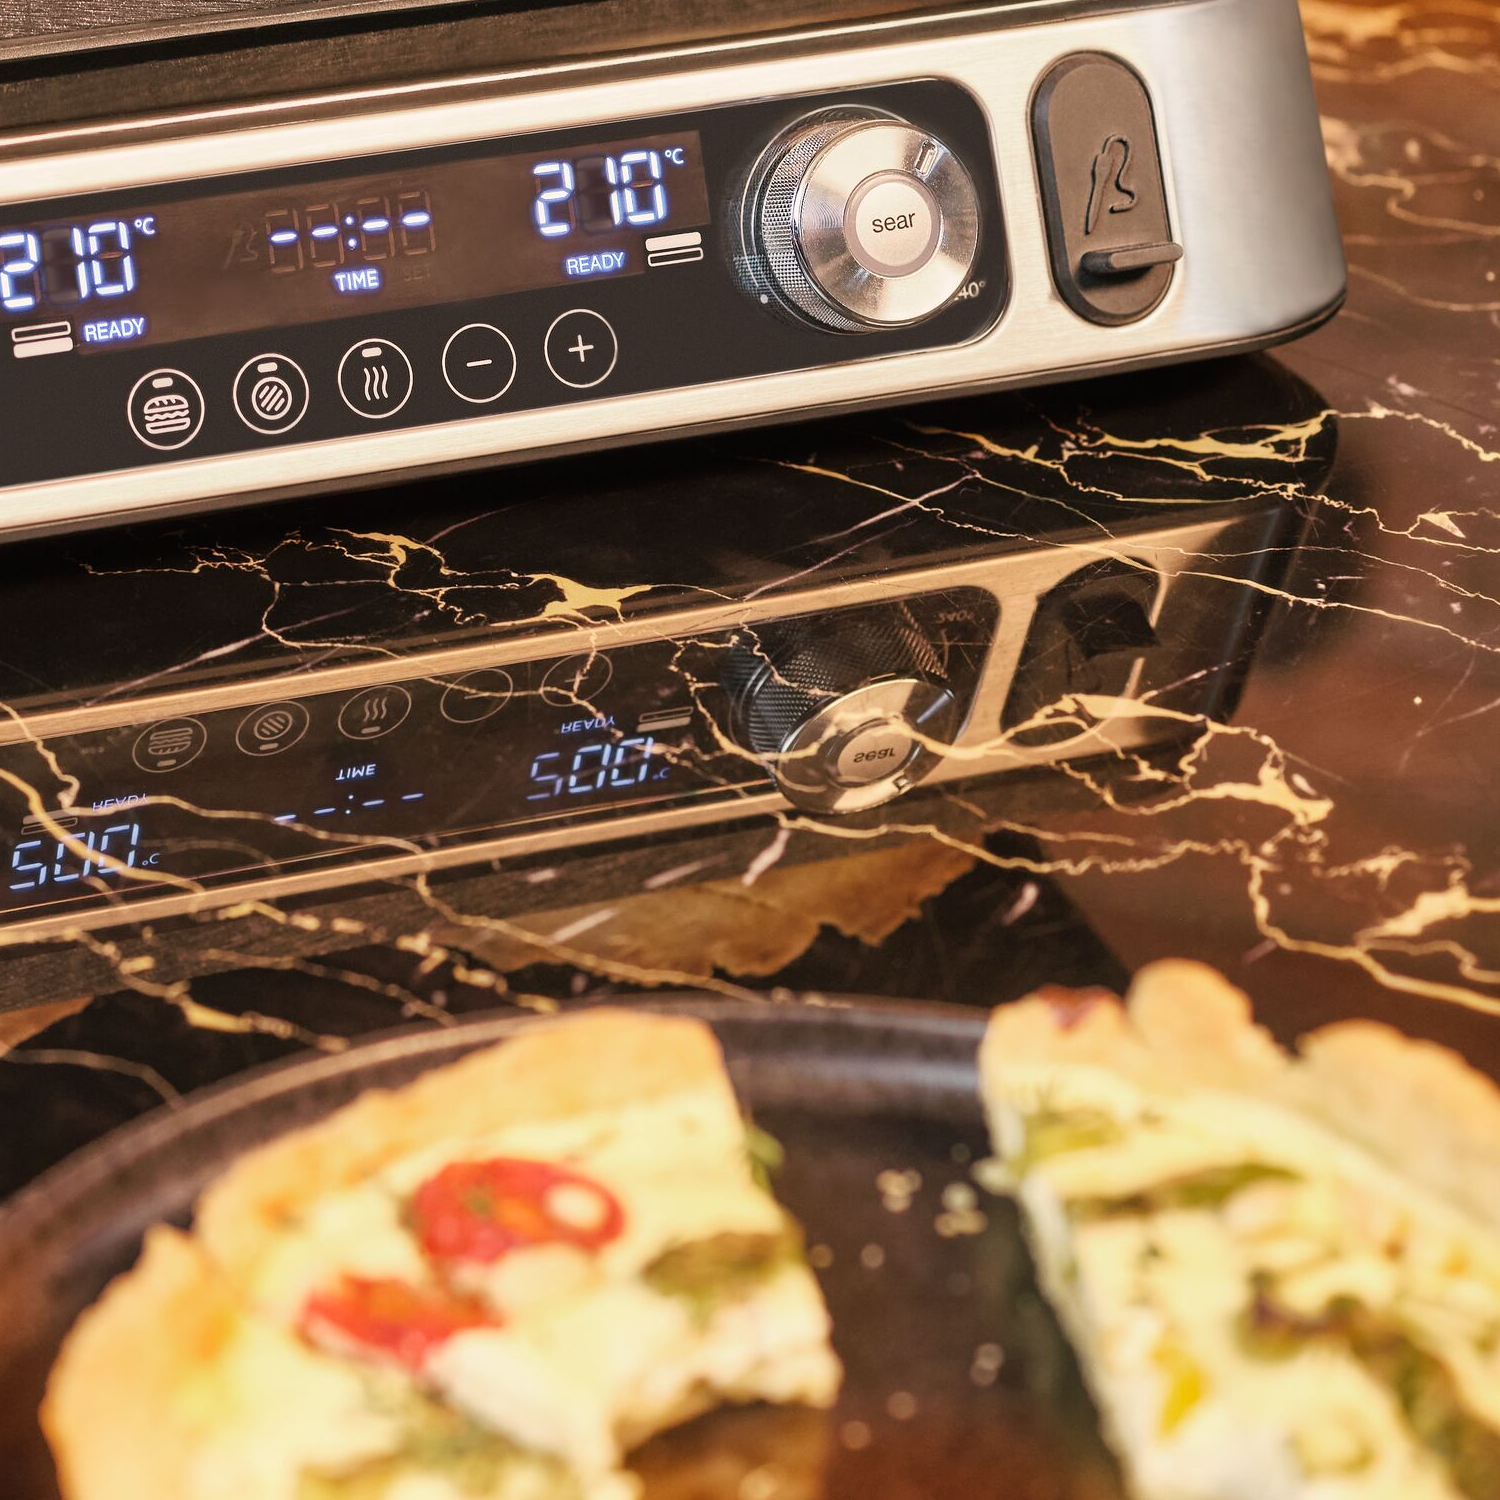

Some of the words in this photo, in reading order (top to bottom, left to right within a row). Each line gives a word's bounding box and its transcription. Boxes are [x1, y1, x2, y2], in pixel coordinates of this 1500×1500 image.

[871, 211, 916, 234] sear
[565, 250, 626, 277] READY
[334, 267, 380, 292] TIME
[83, 316, 146, 343] READY
